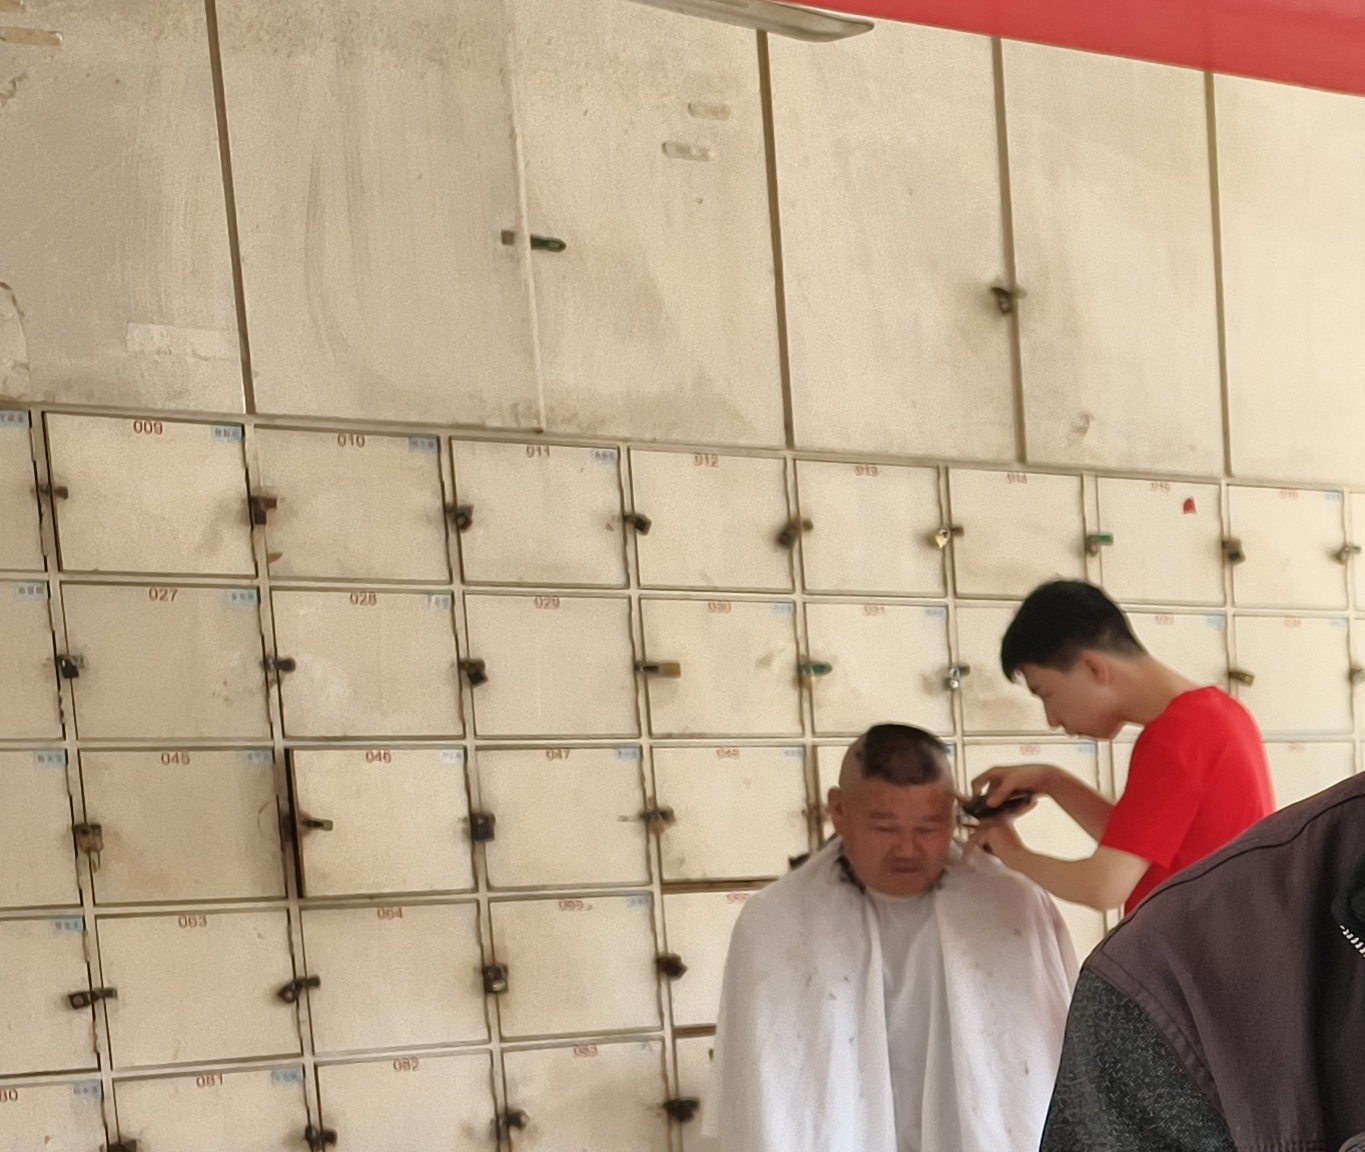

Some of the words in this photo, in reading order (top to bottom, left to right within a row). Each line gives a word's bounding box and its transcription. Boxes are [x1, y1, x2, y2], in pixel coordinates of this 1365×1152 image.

[337, 433, 366, 448] 010
[526, 444, 551, 459] 011
[694, 453, 719, 467] 012
[149, 586, 178, 602] 027
[350, 591, 377, 606] 028
[535, 595, 560, 609] 029
[366, 751, 392, 764] 046
[546, 748, 571, 760] 047
[179, 914, 208, 930] 063
